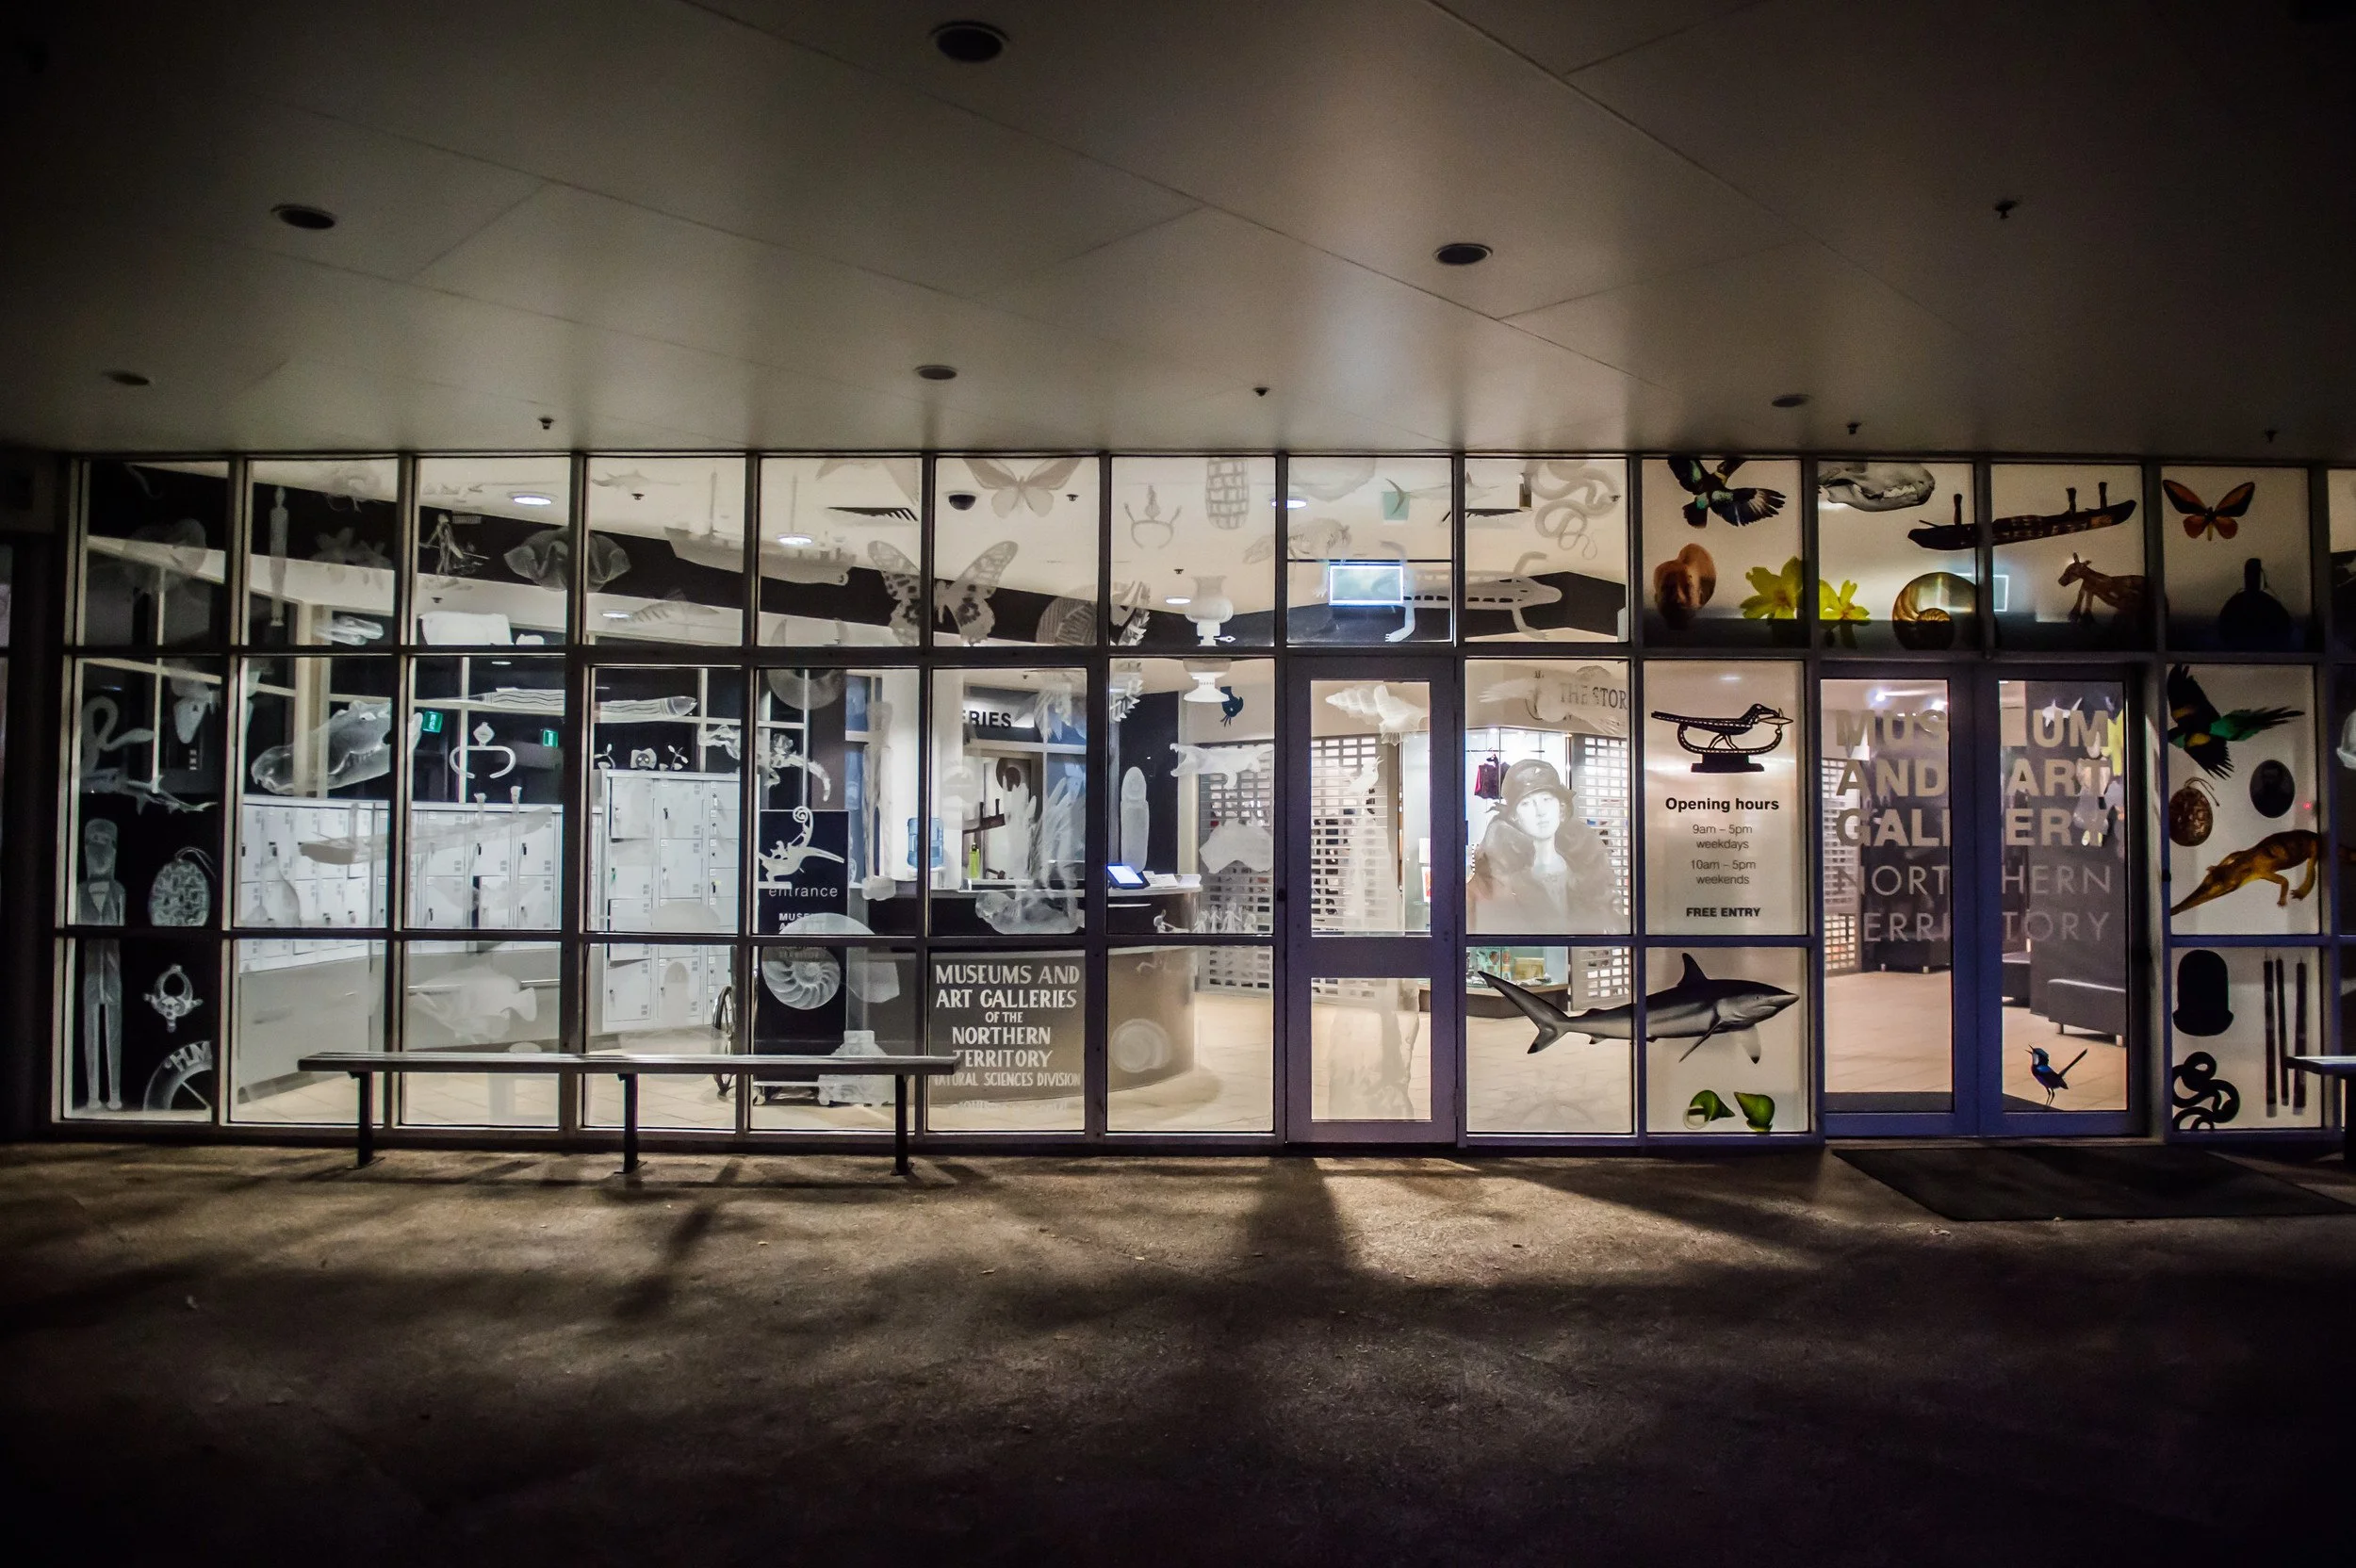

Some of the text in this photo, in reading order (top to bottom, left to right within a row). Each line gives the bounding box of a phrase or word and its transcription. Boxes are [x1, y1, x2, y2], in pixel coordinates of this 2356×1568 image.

[1836, 758, 1947, 797] AND
[2006, 758, 2112, 797] ART
[1665, 797, 1779, 813] Opening hours
[1692, 824, 1716, 835] 9am
[1728, 824, 1753, 837] 5pm
[1695, 839, 1749, 851] weekdays
[1691, 859, 1720, 870] 10am
[1732, 859, 1756, 872] 5pm
[1695, 874, 1750, 885] weekends
[1686, 907, 1761, 917] FREE ENTRY
[935, 964, 1080, 985] MUSEUMS AND
[935, 988, 1077, 1008] ART GALLERIES
[985, 1011, 1023, 1023] OF THE
[952, 1026, 1052, 1045] NORTHERN
[983, 1072, 1034, 1086] SCIENCES
[1037, 1072, 1081, 1086] DIVISION
